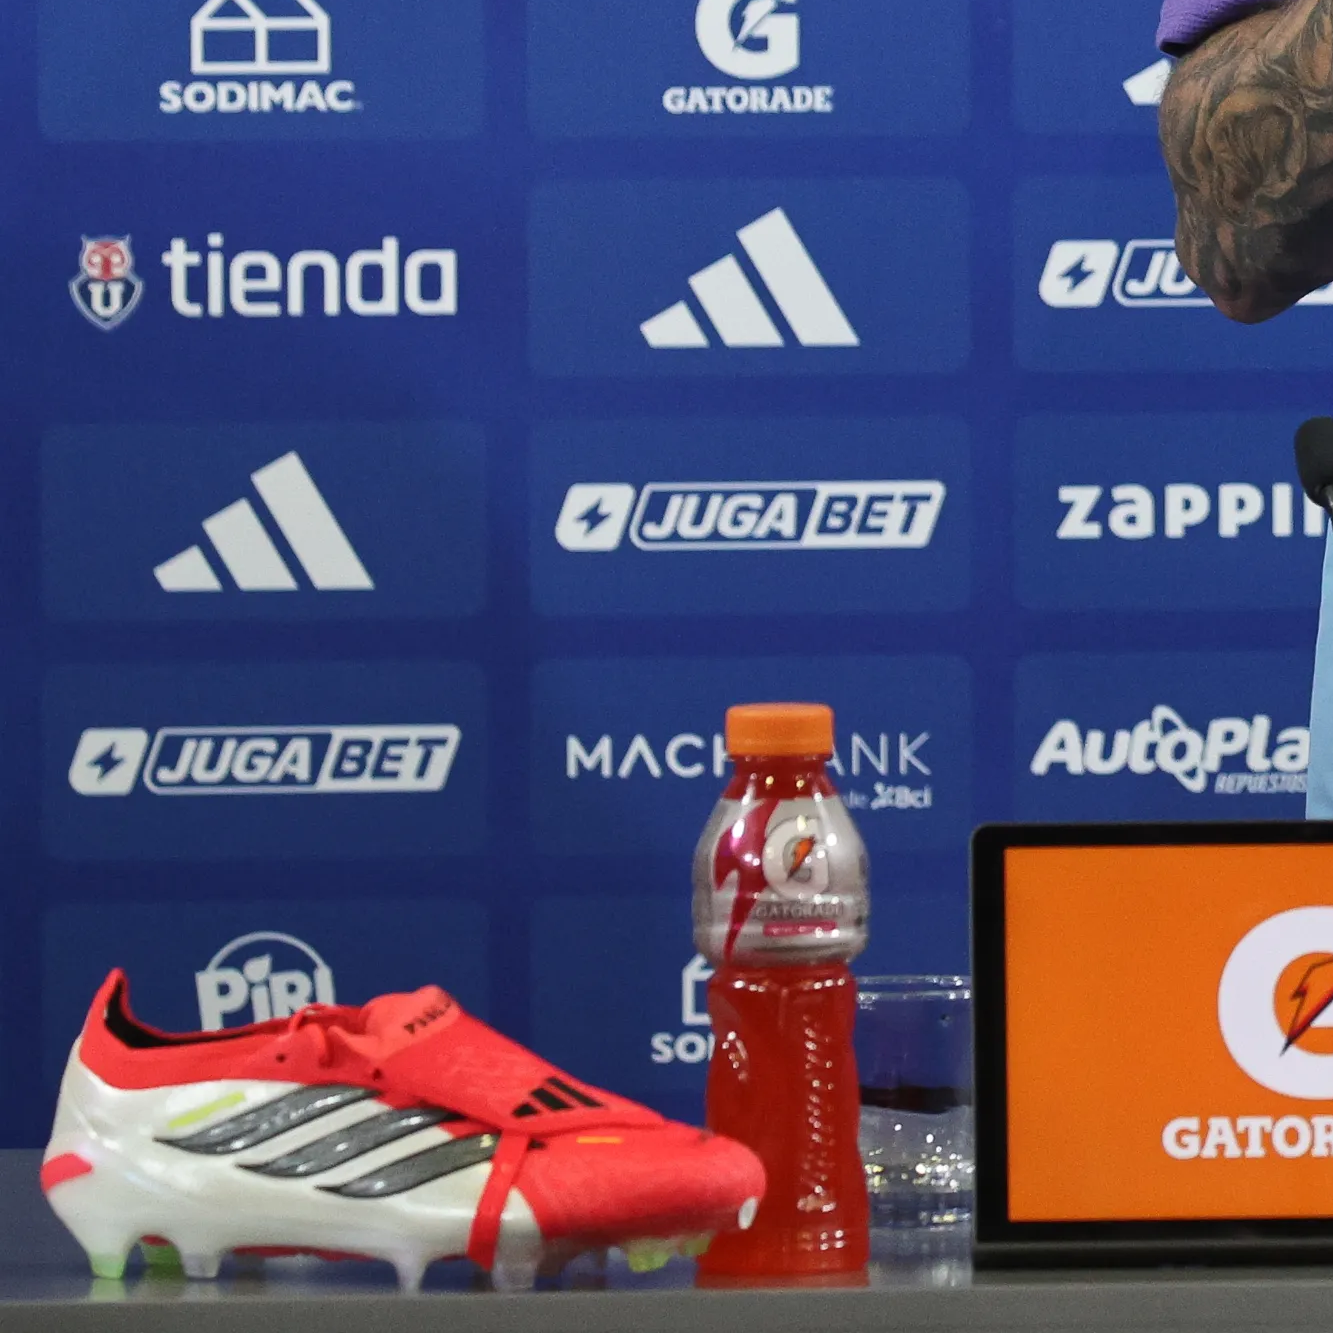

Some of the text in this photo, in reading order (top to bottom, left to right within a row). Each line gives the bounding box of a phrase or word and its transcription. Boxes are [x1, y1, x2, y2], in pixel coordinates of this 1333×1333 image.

[160, 81, 355, 112] SODIMAC
[663, 86, 832, 113] GATORADE
[162, 233, 456, 316] tienda
[87, 280, 124, 317] U
[1029, 705, 1309, 793] AutoPla
